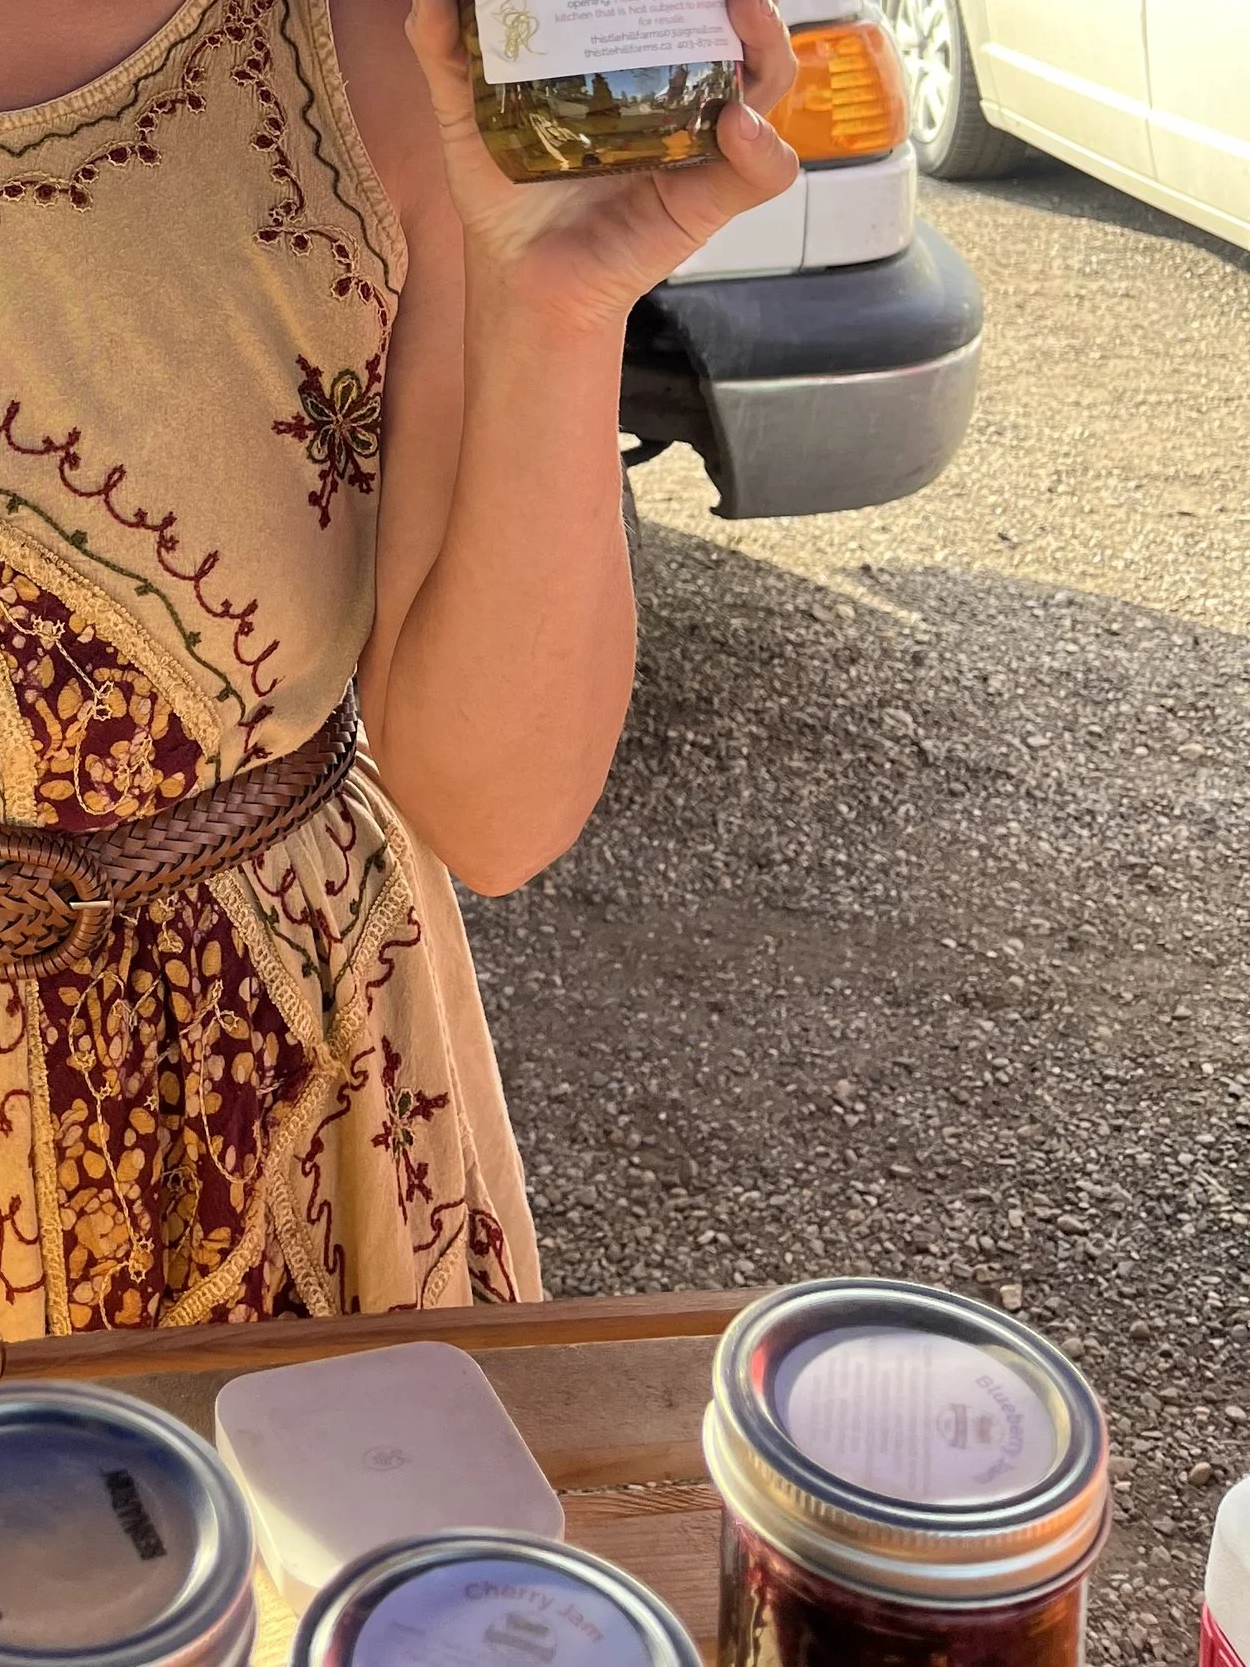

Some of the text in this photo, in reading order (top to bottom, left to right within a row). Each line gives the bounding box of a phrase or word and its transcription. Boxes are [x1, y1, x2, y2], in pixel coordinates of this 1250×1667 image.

[555, 10, 593, 23] kitchen
[595, 7, 616, 19] that
[617, 6, 626, 16] is
[628, 5, 648, 16] Not
[638, 15, 653, 27] for
[464, 1581, 555, 1612] Cherry
[556, 1604, 606, 1644] Jam
